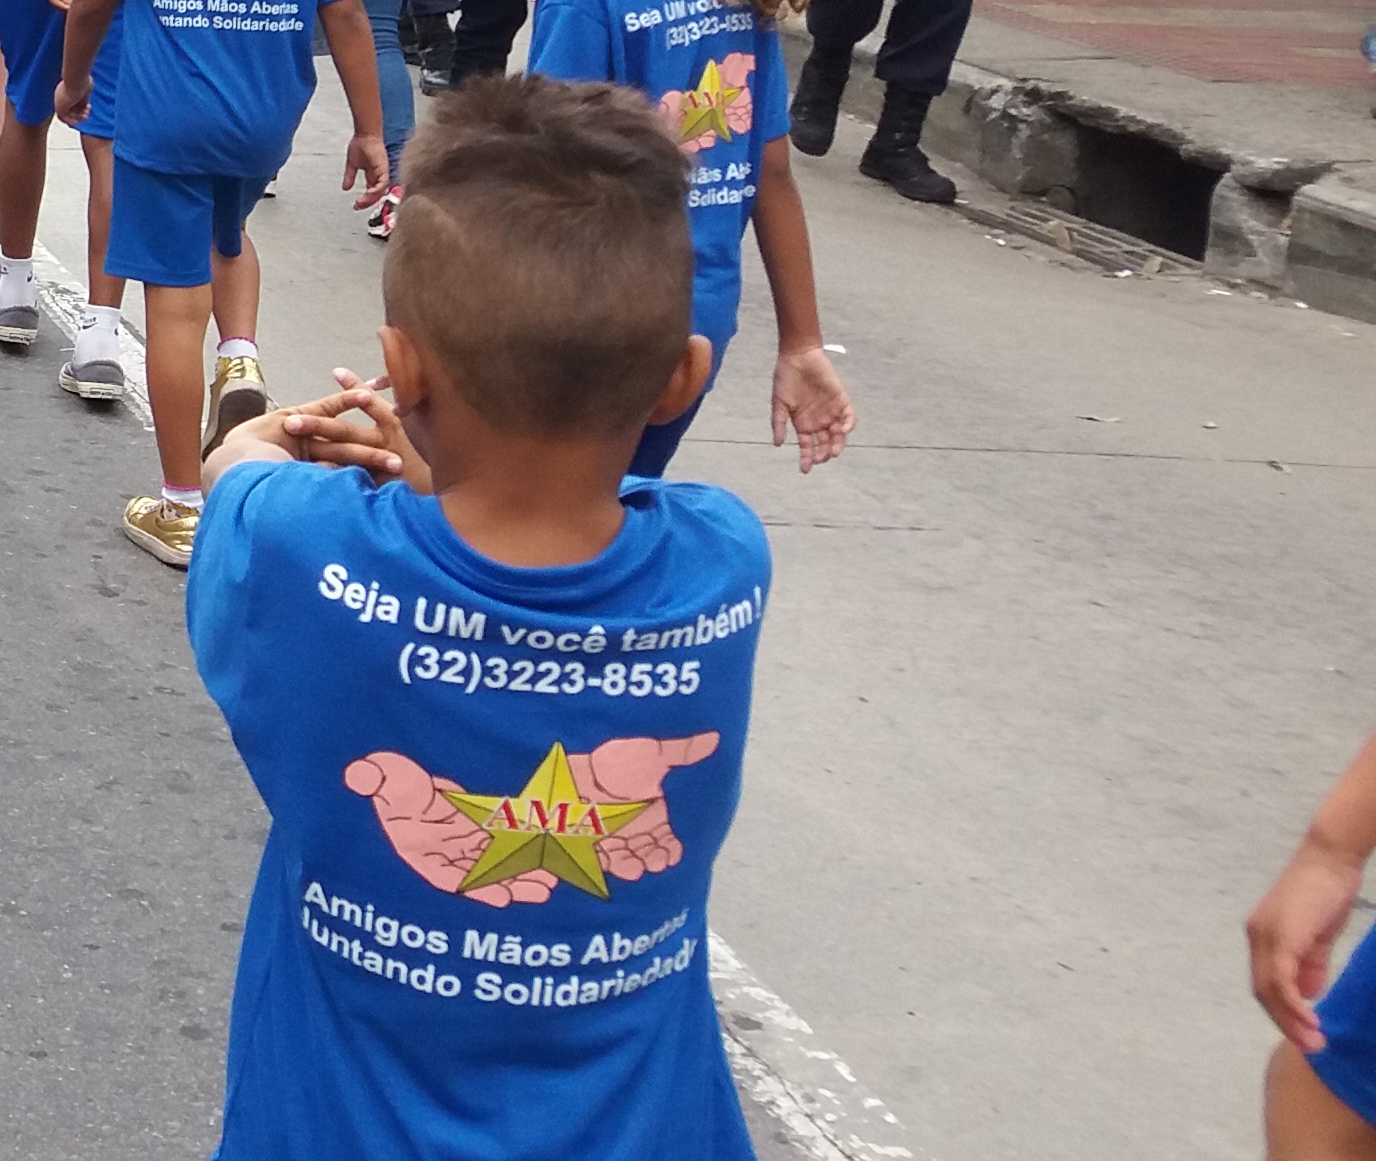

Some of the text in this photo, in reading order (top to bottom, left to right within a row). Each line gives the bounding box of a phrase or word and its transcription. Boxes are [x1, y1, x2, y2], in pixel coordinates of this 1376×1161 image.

[318, 563, 753, 655] Seja UM você também
[398, 640, 702, 698] (32)3223-8535
[485, 796, 607, 838] AMA
[302, 879, 449, 956] Amigos
[462, 927, 571, 969] Mãos
